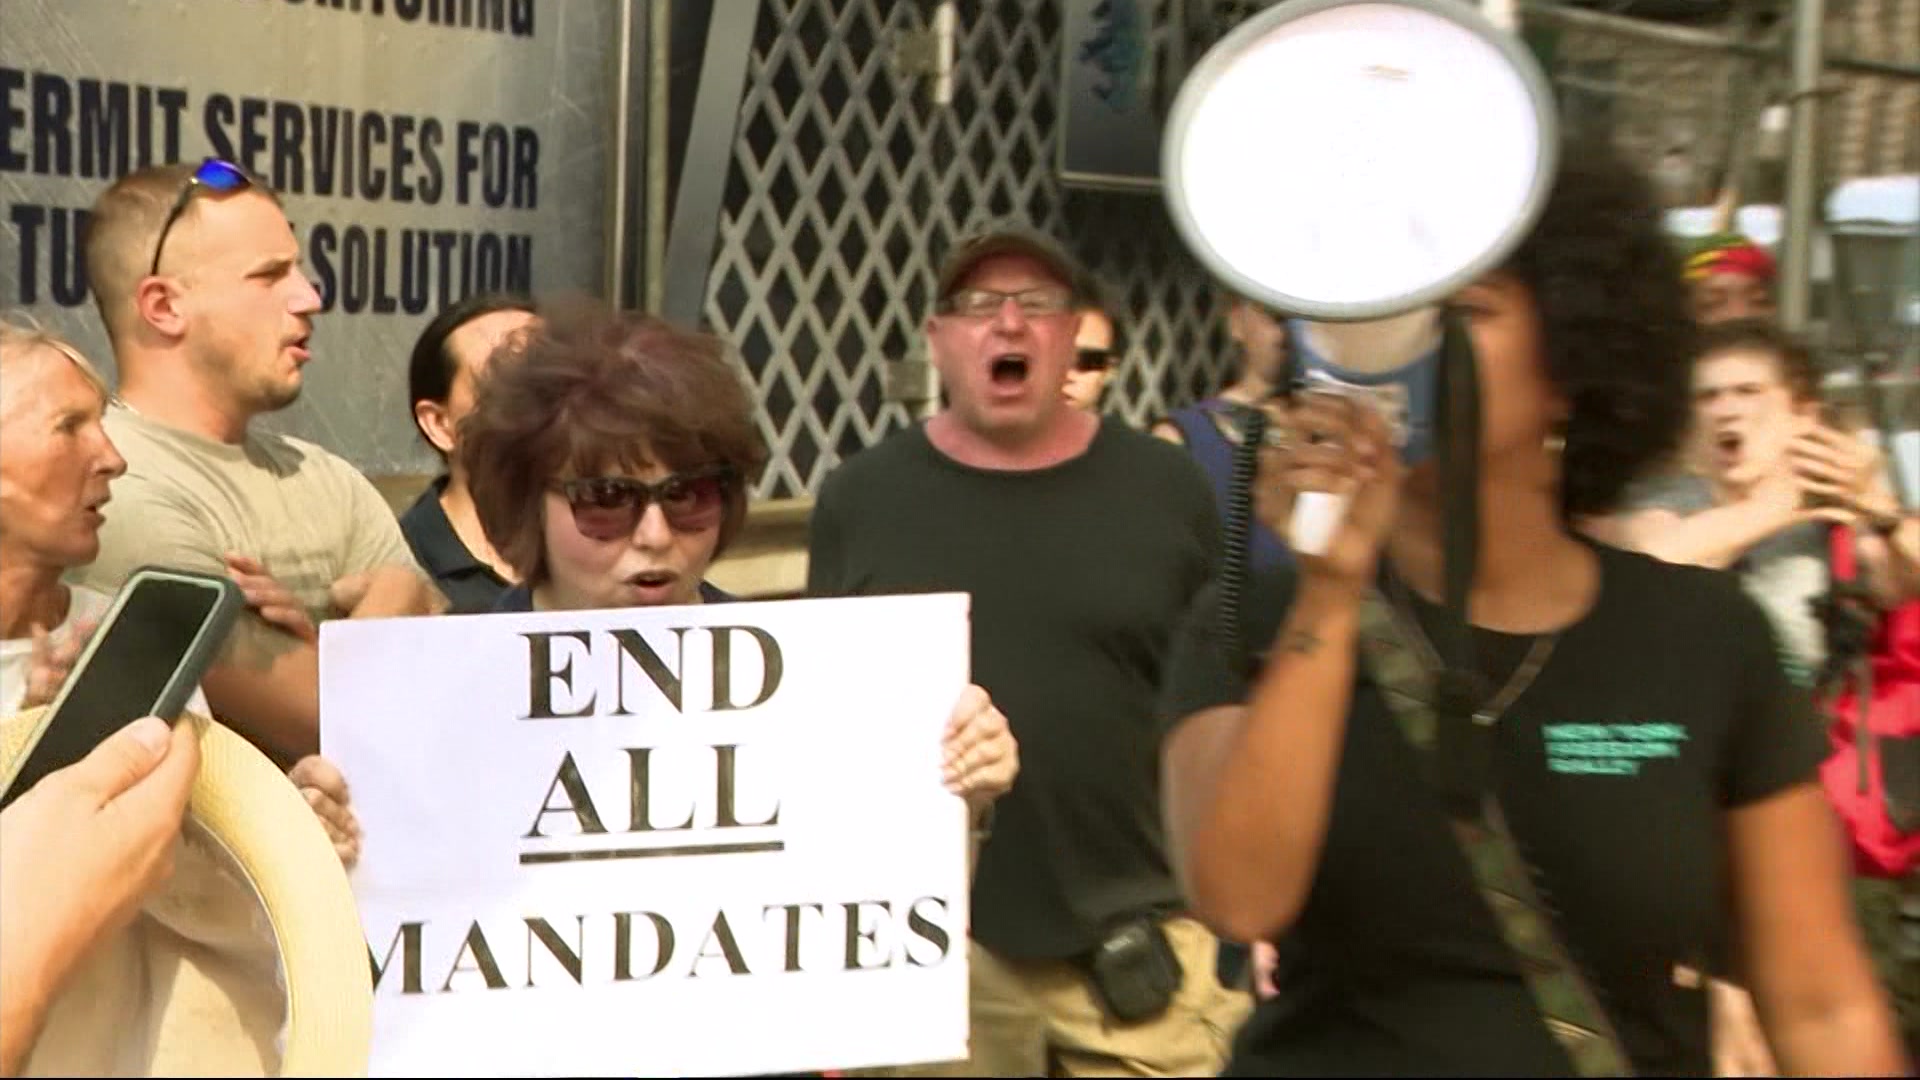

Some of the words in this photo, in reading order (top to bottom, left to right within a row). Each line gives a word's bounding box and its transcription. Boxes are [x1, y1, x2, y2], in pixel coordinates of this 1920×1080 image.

[204, 92, 444, 206] SERVICES
[455, 120, 539, 210] FOR
[309, 222, 532, 315] SOLUTION
[518, 624, 784, 720] END
[521, 743, 781, 838] ALL
[364, 896, 950, 995] MANDATES
